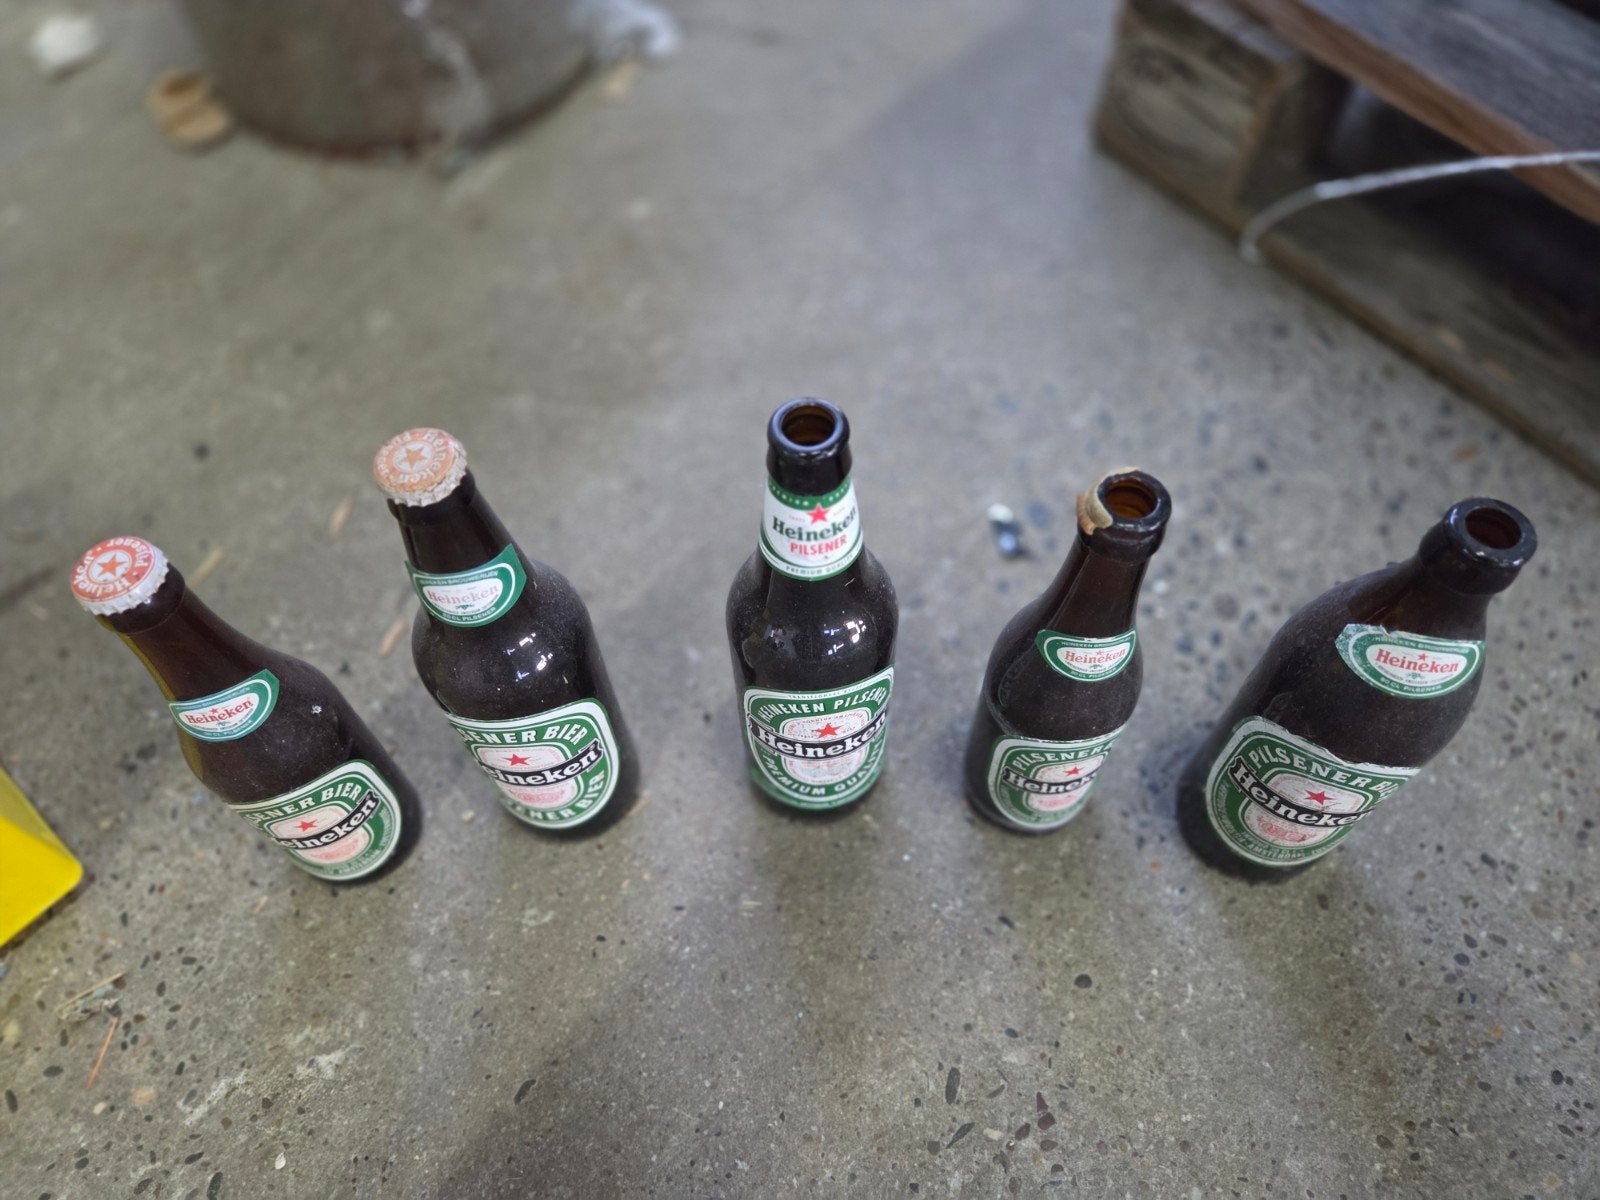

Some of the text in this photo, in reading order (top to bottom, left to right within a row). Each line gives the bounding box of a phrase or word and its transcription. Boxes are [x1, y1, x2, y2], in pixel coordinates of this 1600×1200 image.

[772, 506, 856, 541] Heineken
[789, 534, 847, 556] PILSENER
[427, 585, 499, 605] Heineken
[1064, 648, 1126, 664] Heineken
[1375, 648, 1459, 674] Heineken
[184, 699, 254, 724] Heineken
[757, 702, 825, 723] HEINEKEN
[543, 723, 588, 745] BIER
[757, 711, 887, 757] Heineken
[1012, 744, 1104, 771] PILSENER
[1249, 745, 1372, 789] PILSENER
[761, 754, 826, 796] PREMIUM
[321, 782, 362, 802] BIER
[576, 769, 606, 809] BIER
[280, 796, 378, 850] eineken
